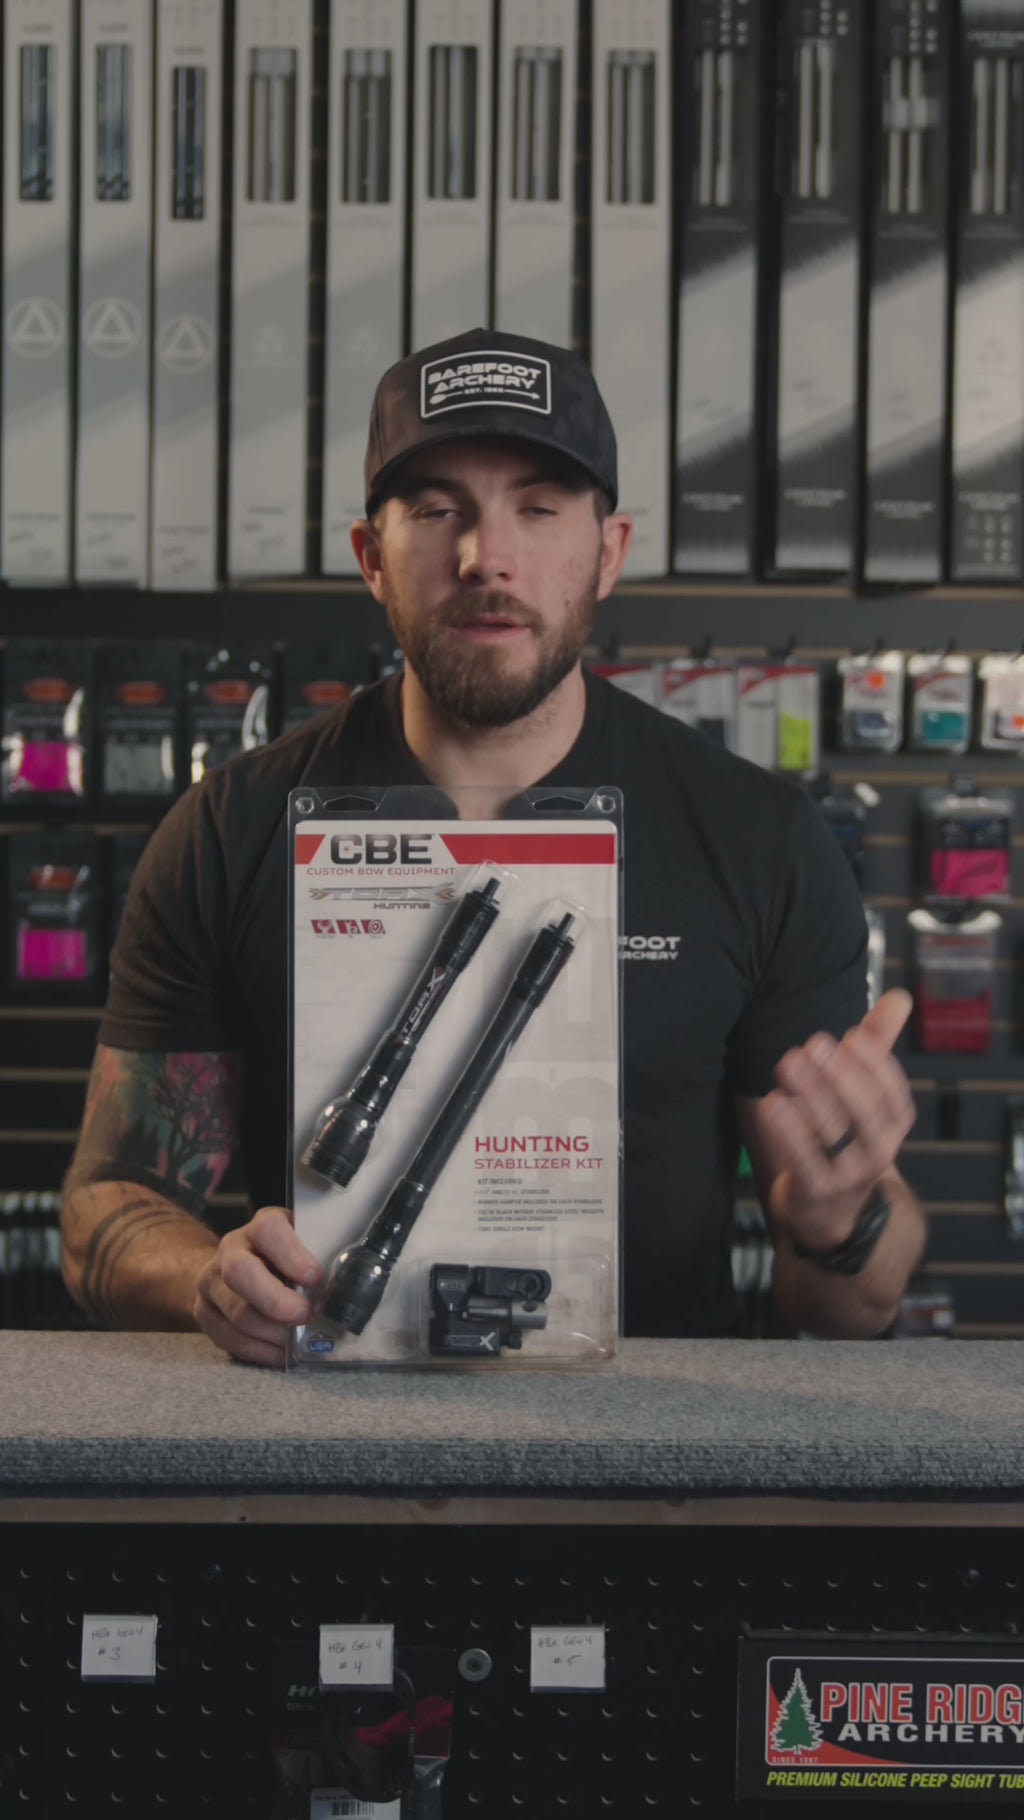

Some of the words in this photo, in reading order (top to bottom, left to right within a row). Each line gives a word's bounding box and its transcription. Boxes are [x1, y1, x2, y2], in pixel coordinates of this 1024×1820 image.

[428, 363, 541, 384] BAREFOOT
[433, 374, 535, 393] ARCHERY
[330, 834, 432, 865] CBE
[307, 867, 354, 876] CUSTOM
[358, 867, 384, 876] BOW
[388, 867, 456, 876] EQUIPMENT
[373, 902, 431, 910] HUNTING
[617, 936, 682, 950] FOOT
[474, 1135, 590, 1154] HUNTING
[474, 1157, 571, 1170] STABILIZER
[576, 1157, 604, 1170] KIT
[375, 1637, 382, 1650] 4
[820, 1682, 913, 1724] PINE
[926, 1684, 1024, 1725] RIDG
[837, 1723, 1024, 1744] ARCHERY
[772, 1756, 796, 1764] SINCE
[766, 1772, 838, 1787] PREMIUM
[840, 1772, 907, 1787] SILICONE
[910, 1773, 948, 1788] PEEP
[950, 1774, 995, 1788] SIGHT
